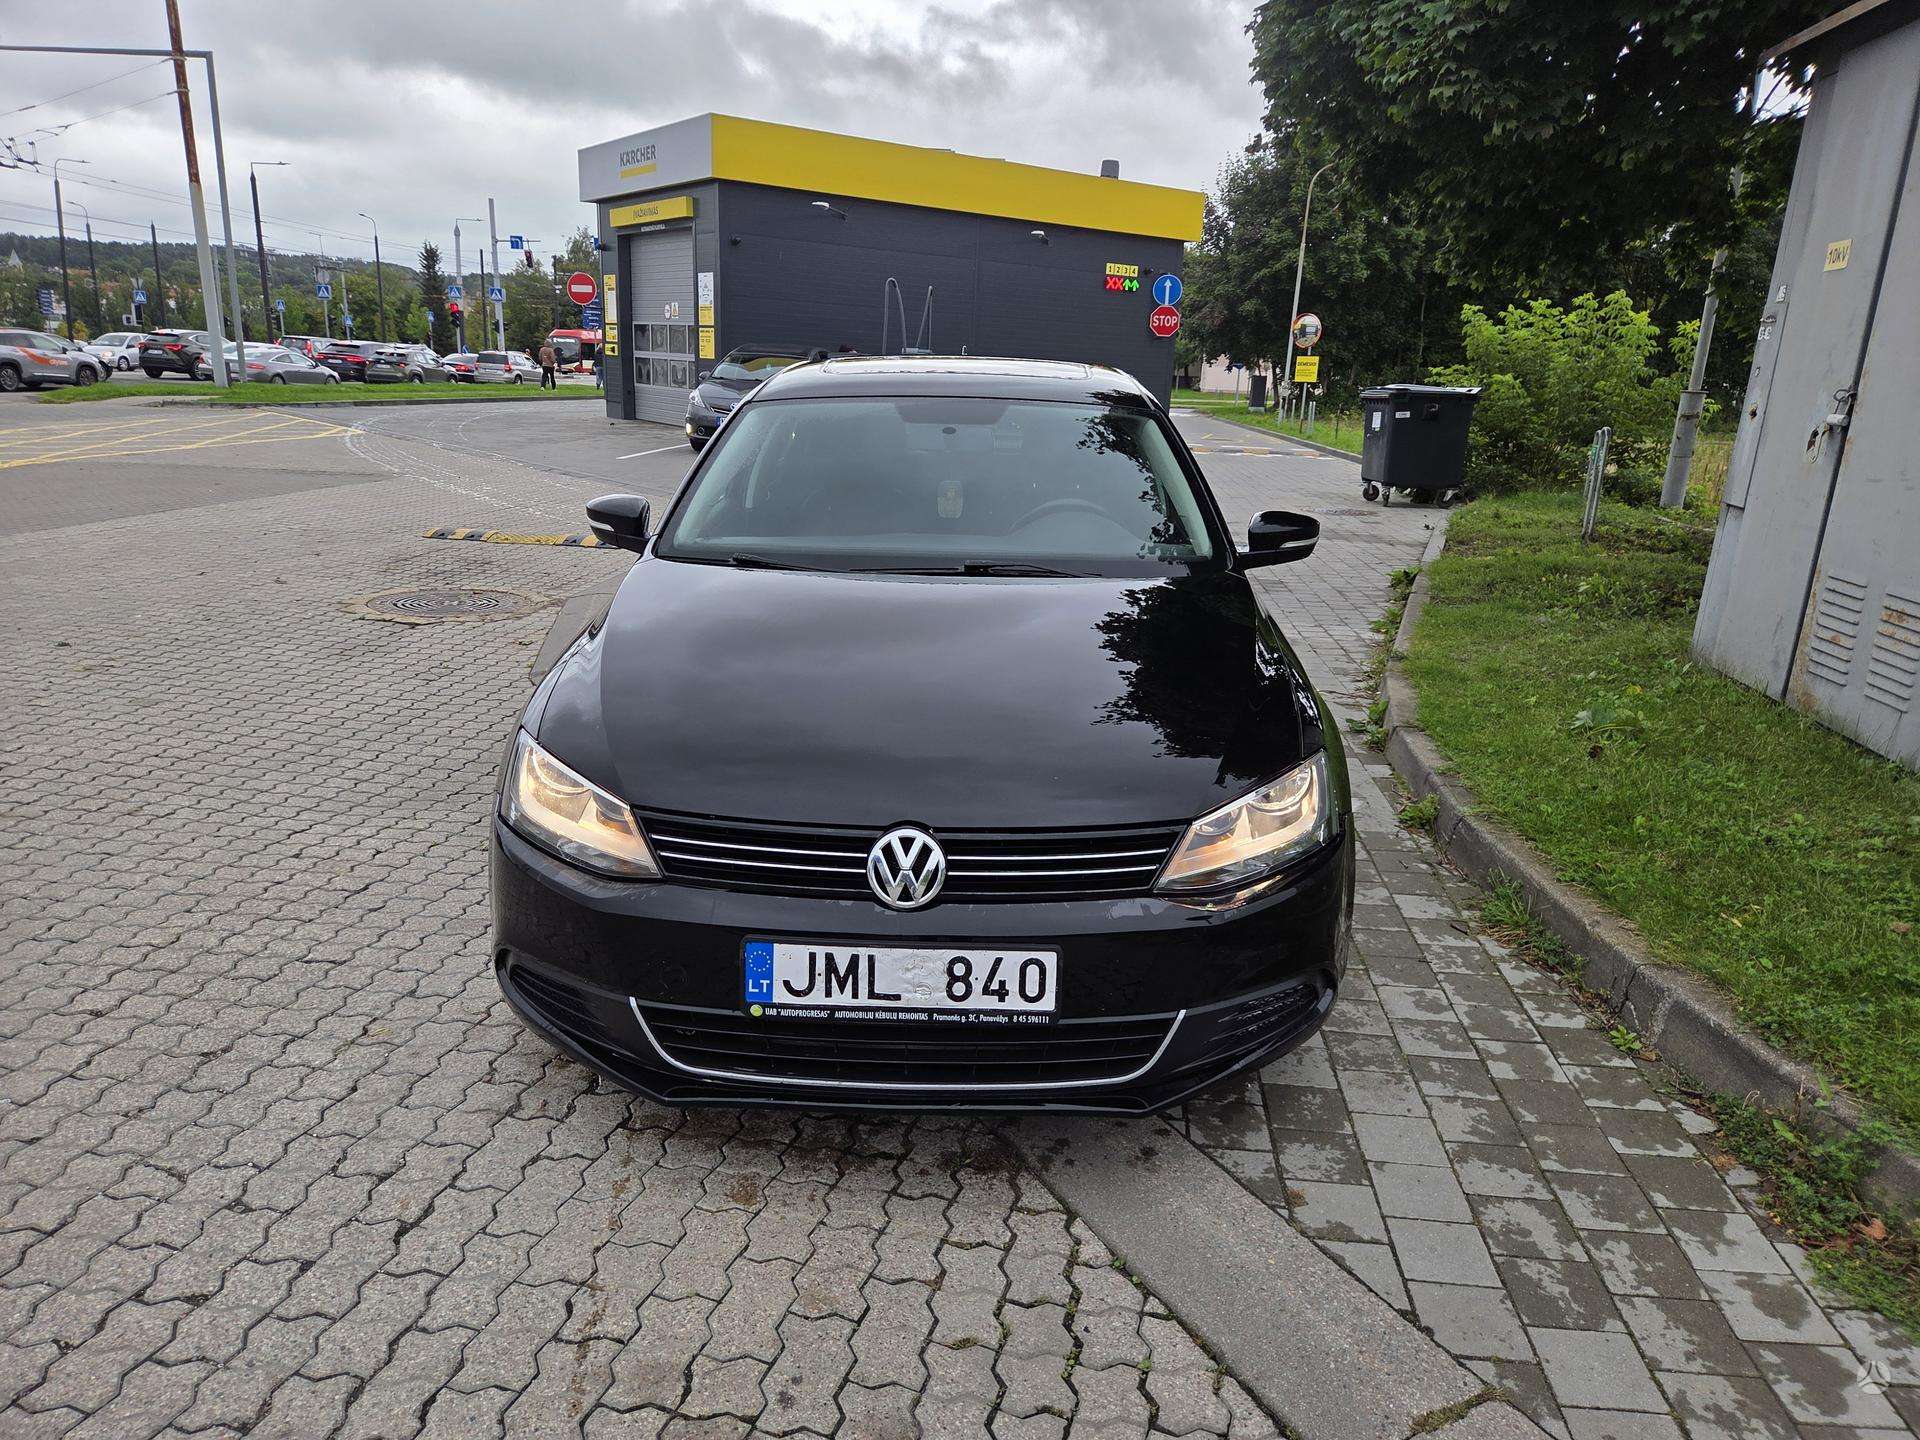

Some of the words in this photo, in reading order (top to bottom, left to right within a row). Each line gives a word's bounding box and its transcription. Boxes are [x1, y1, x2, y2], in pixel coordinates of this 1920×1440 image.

[1828, 246, 1849, 264] 10kV
[1153, 315, 1178, 327] STOP
[782, 951, 902, 1001] JML
[945, 955, 1047, 1004] 840
[748, 979, 770, 993] LT
[765, 1007, 778, 1016] UAB
[898, 1012, 929, 1021] REMONTAS
